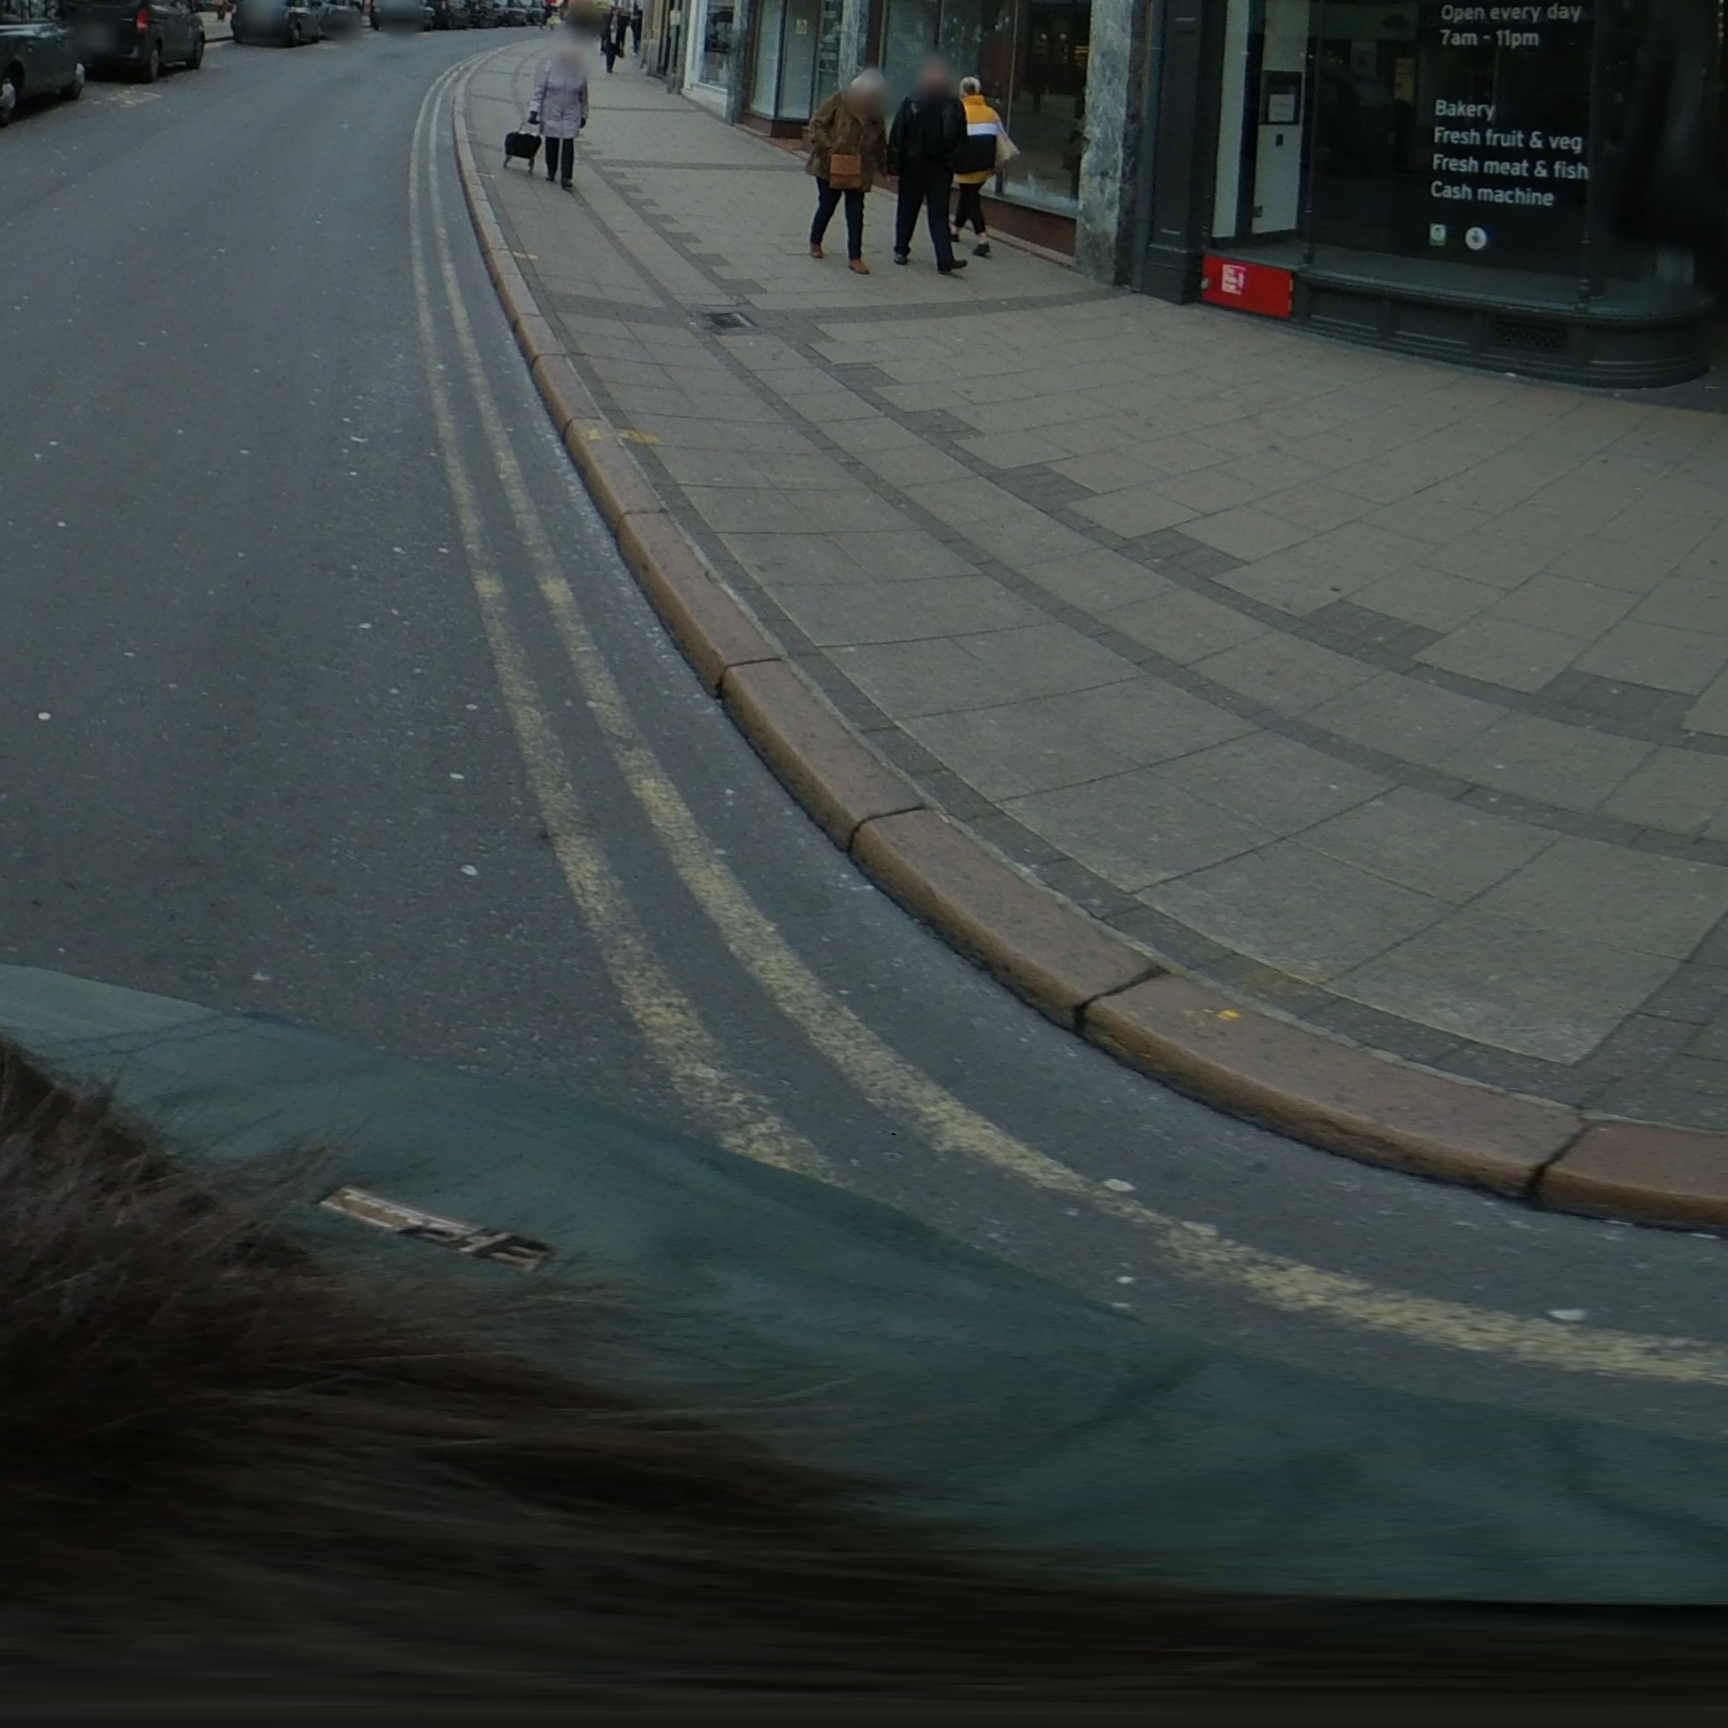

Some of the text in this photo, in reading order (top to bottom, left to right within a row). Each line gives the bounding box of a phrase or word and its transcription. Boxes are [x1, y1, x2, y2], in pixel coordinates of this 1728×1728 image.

[1441, 2, 1582, 23] Open every day
[1440, 29, 1478, 46] 7am
[1495, 29, 1540, 50] 11pm
[1434, 99, 1496, 122] Bakery
[1433, 126, 1584, 155] Fresh fruit & veg
[1432, 153, 1590, 180] Fresh meat & fish
[1430, 180, 1556, 207] Cash machine
